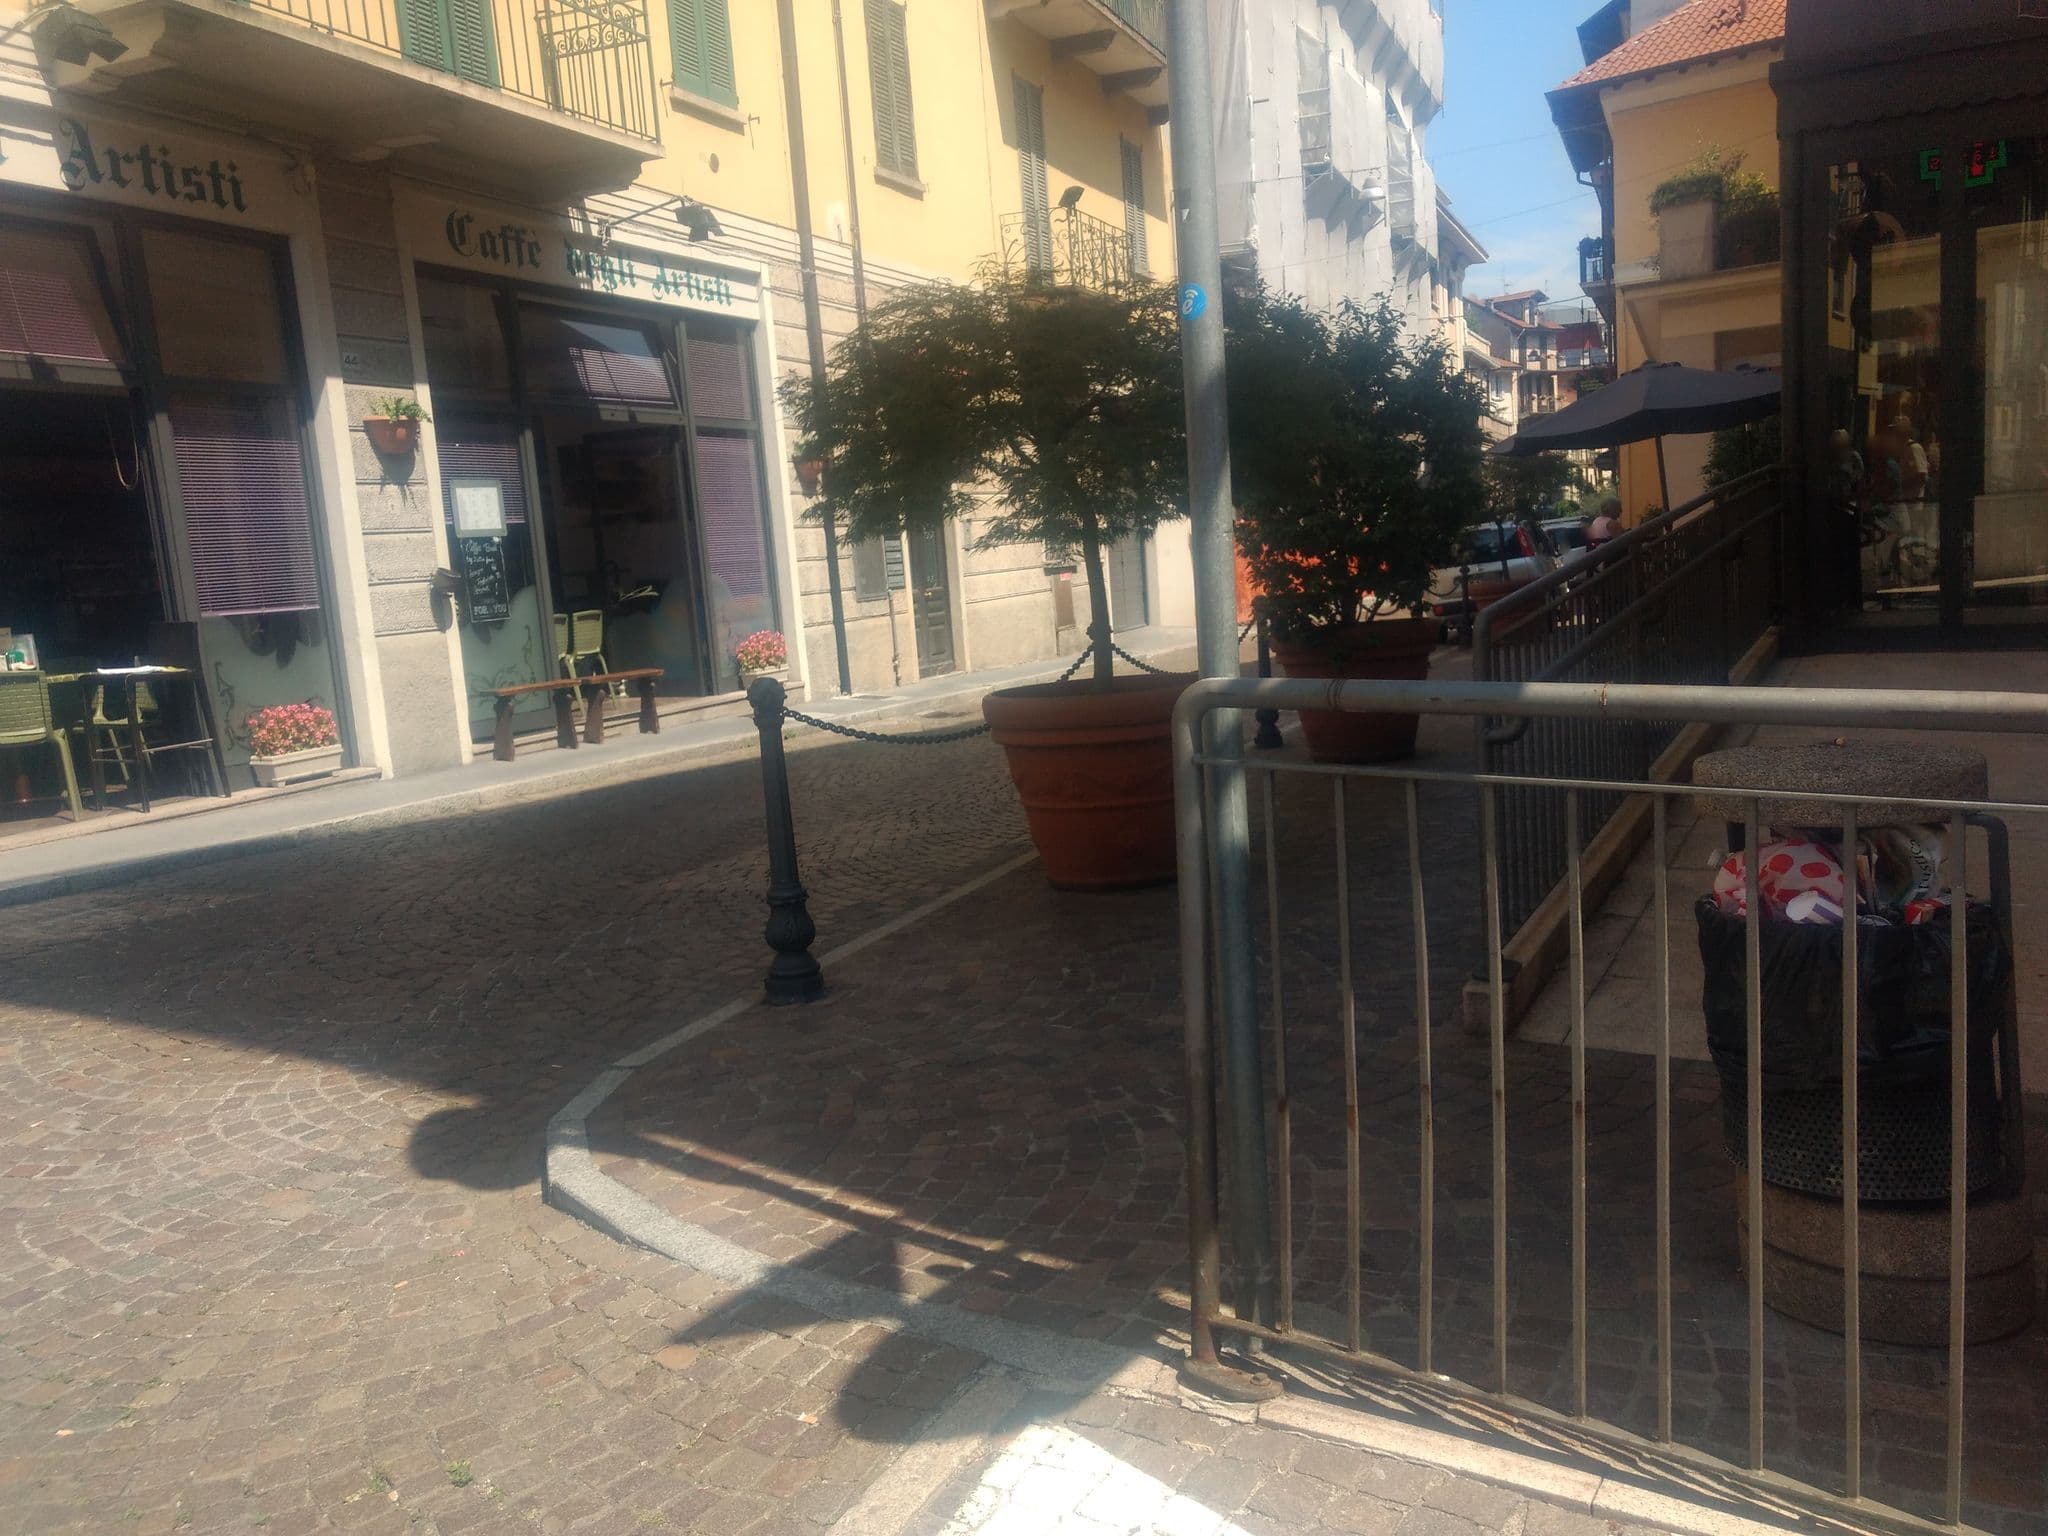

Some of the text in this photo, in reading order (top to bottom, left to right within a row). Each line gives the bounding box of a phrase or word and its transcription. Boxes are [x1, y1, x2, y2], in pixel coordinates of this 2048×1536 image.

[59, 118, 248, 213] Artisti
[564, 236, 637, 295] degli
[652, 254, 733, 307] Artisti
